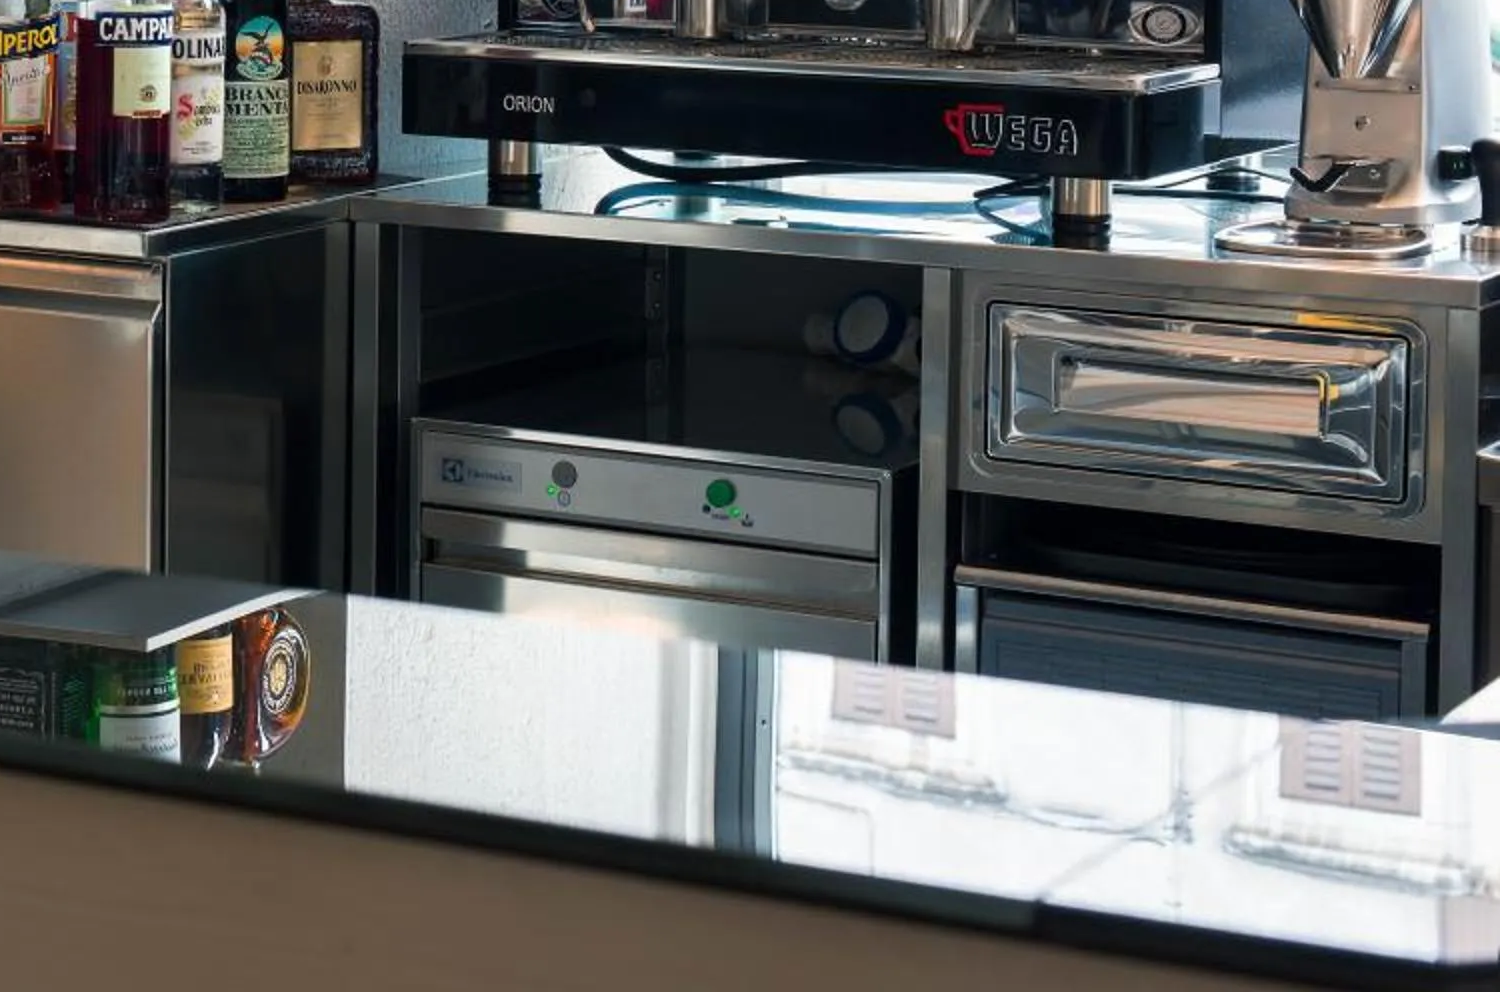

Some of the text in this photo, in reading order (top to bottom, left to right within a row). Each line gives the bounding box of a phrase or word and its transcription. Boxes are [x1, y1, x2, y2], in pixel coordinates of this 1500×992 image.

[100, 16, 172, 42] CAMPA
[172, 34, 226, 59] OLINA
[296, 78, 357, 97] DISARONNO
[503, 94, 555, 113] ORION
[965, 111, 1078, 157] WEGA
